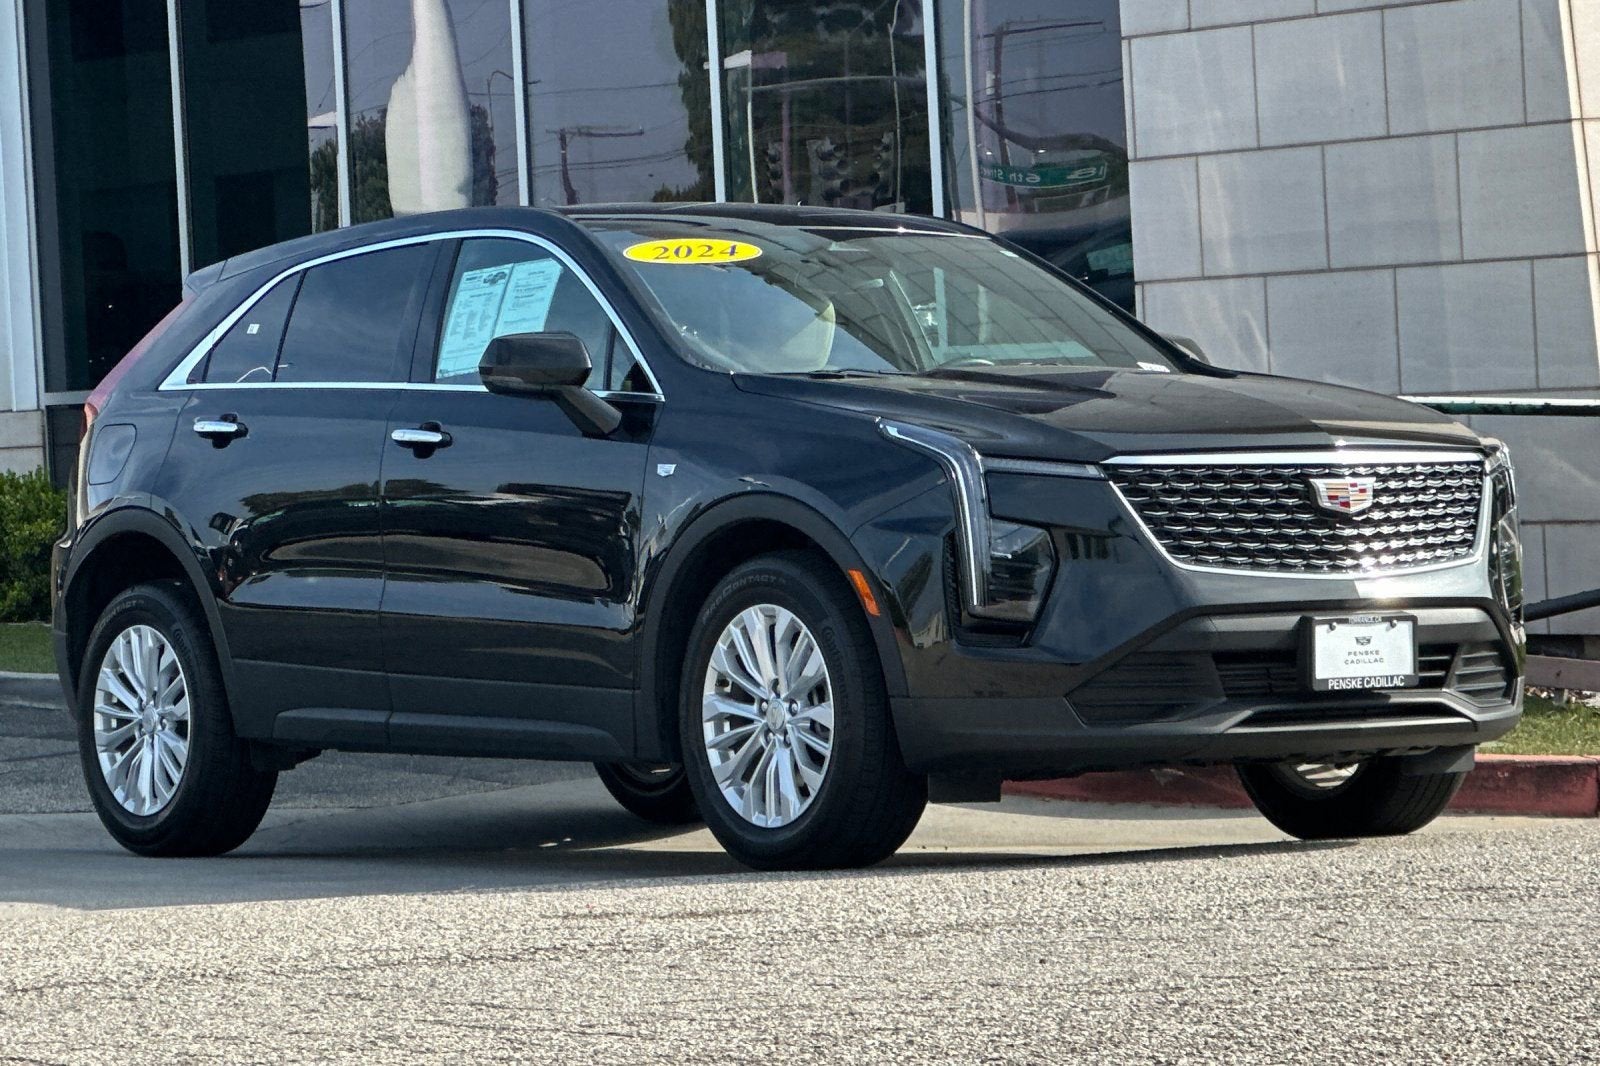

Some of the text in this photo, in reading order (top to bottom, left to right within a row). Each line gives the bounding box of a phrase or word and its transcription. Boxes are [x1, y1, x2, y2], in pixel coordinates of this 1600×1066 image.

[653, 244, 739, 260] 2024
[1344, 657, 1385, 665] CADILLAC
[1328, 675, 1405, 690] PENSKE CADILLAC
